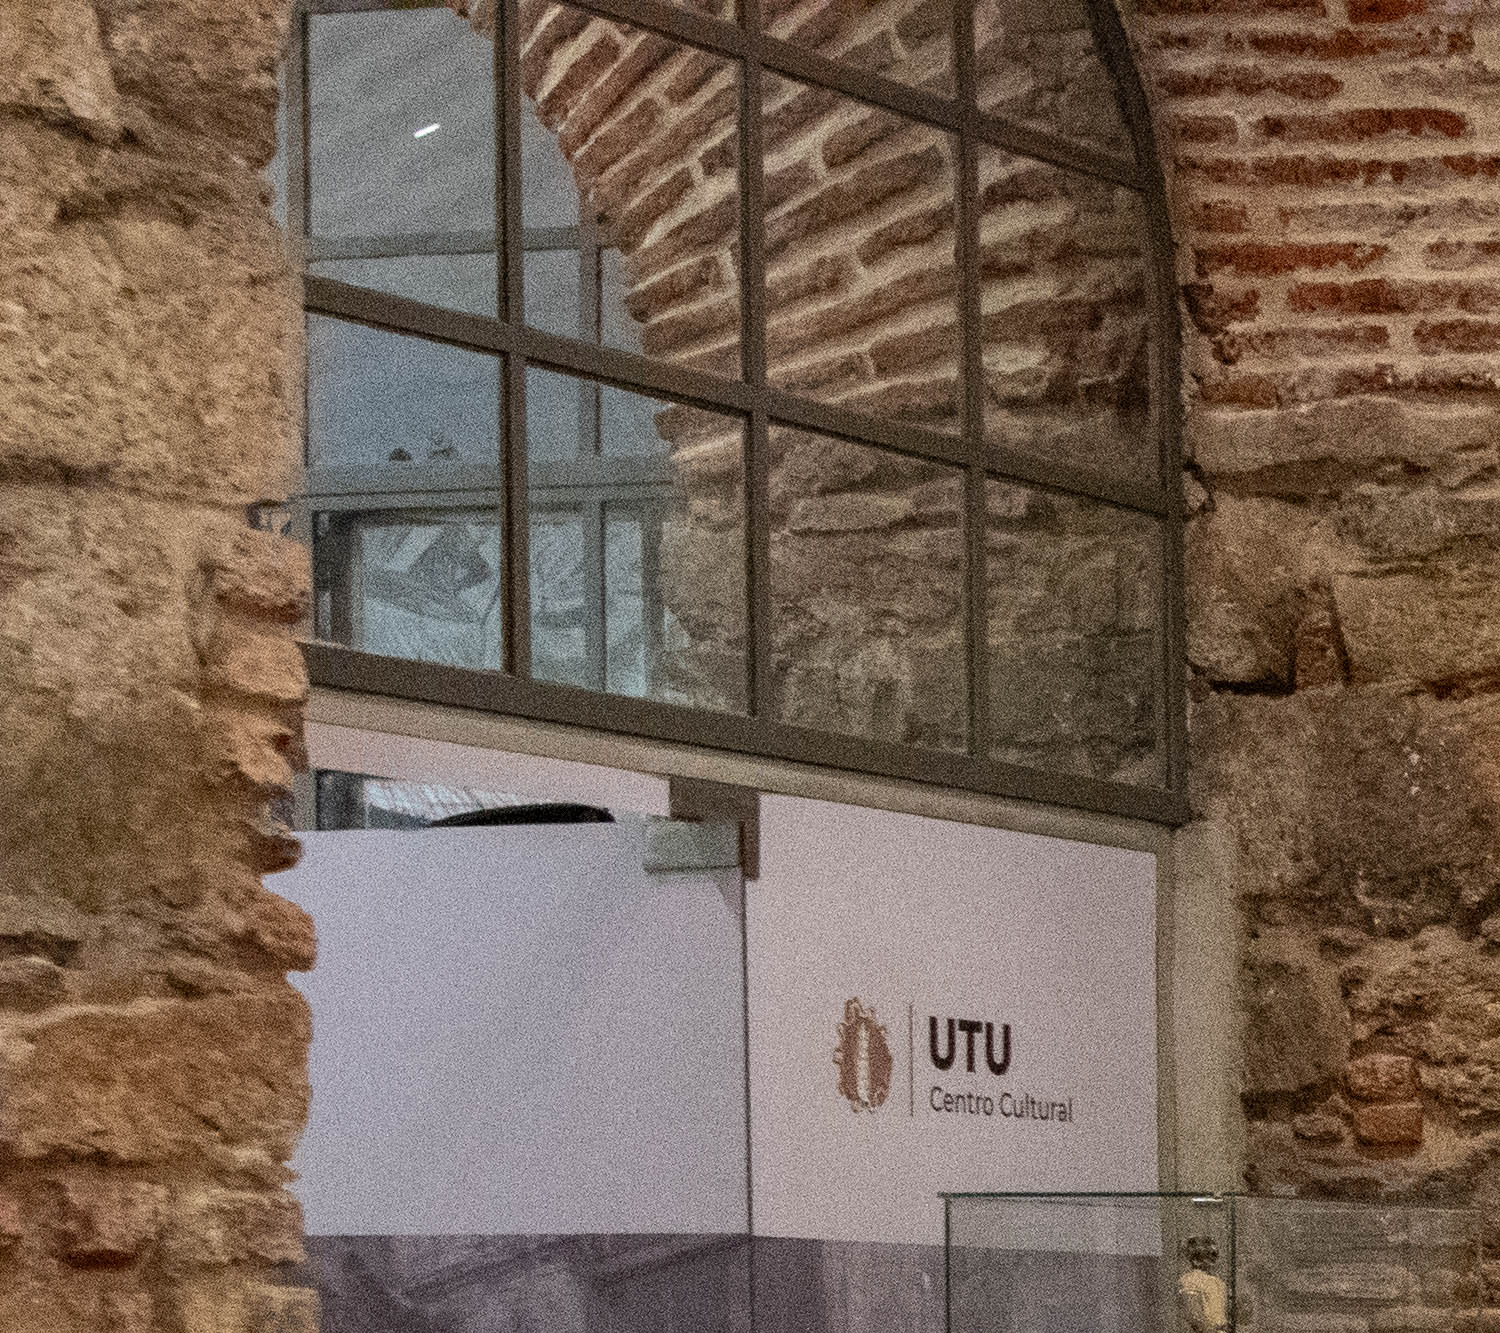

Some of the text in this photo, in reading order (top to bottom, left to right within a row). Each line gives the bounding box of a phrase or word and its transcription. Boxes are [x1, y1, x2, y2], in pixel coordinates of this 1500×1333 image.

[928, 1014, 1012, 1076] UTU
[929, 1085, 1074, 1123] Centro Cultural
